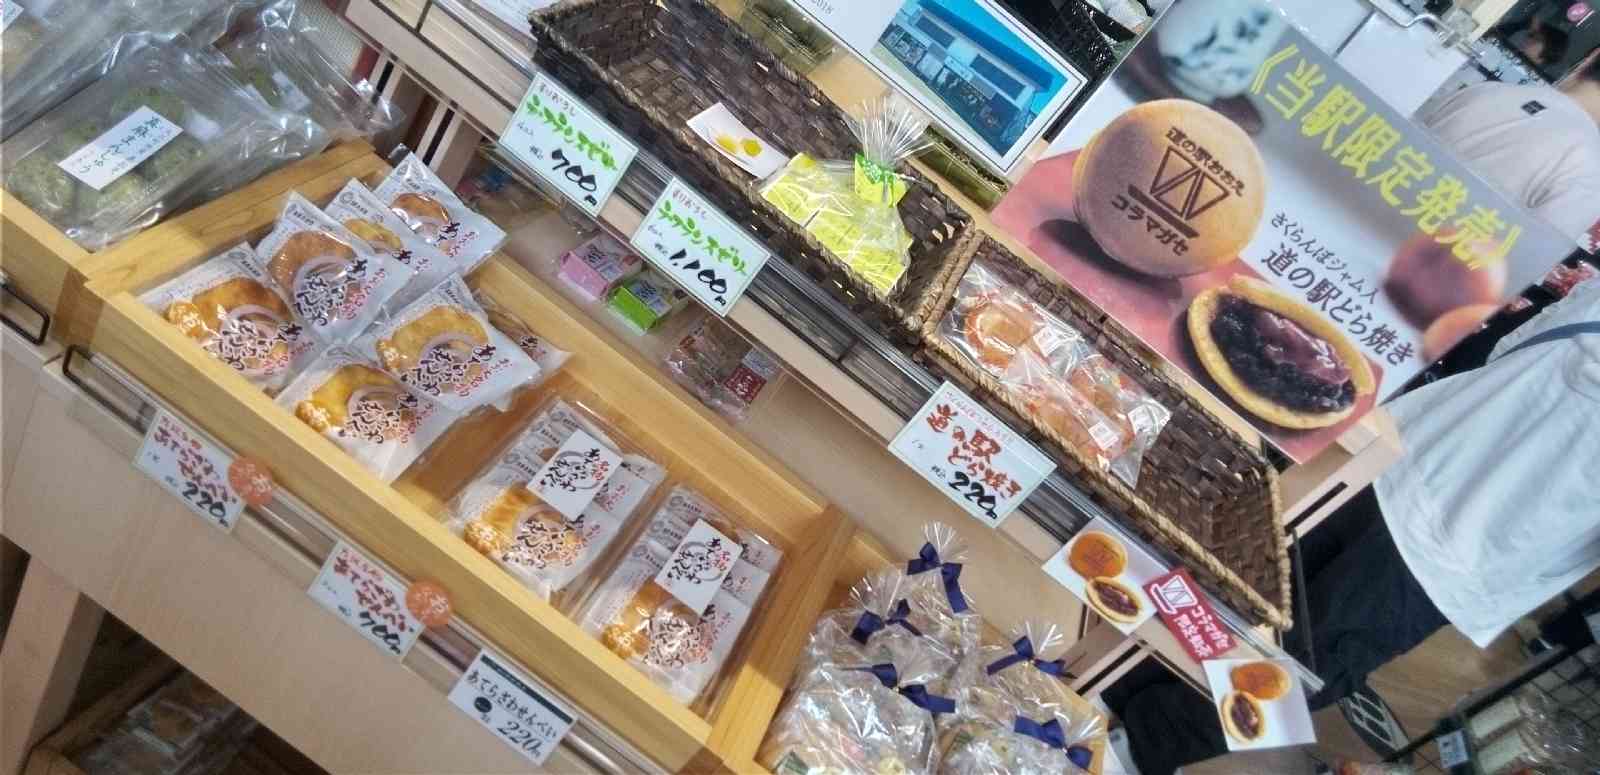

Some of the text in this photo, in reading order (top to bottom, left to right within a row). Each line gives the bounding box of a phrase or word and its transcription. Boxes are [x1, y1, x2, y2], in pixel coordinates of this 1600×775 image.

[1165, 126, 1244, 196] 道の駅おおえ
[1251, 44, 1521, 270] 《当駅限定発売》
[1111, 194, 1188, 256] コラマガセ
[1271, 212, 1380, 304] さくらんぼジャム入
[1260, 241, 1416, 368] 道の駅どら焼き
[926, 404, 1001, 464] 道の駅
[950, 446, 1023, 500] どら焼き
[1191, 604, 1228, 647] コラマガセ
[466, 671, 557, 738] あてらざわせんべい
